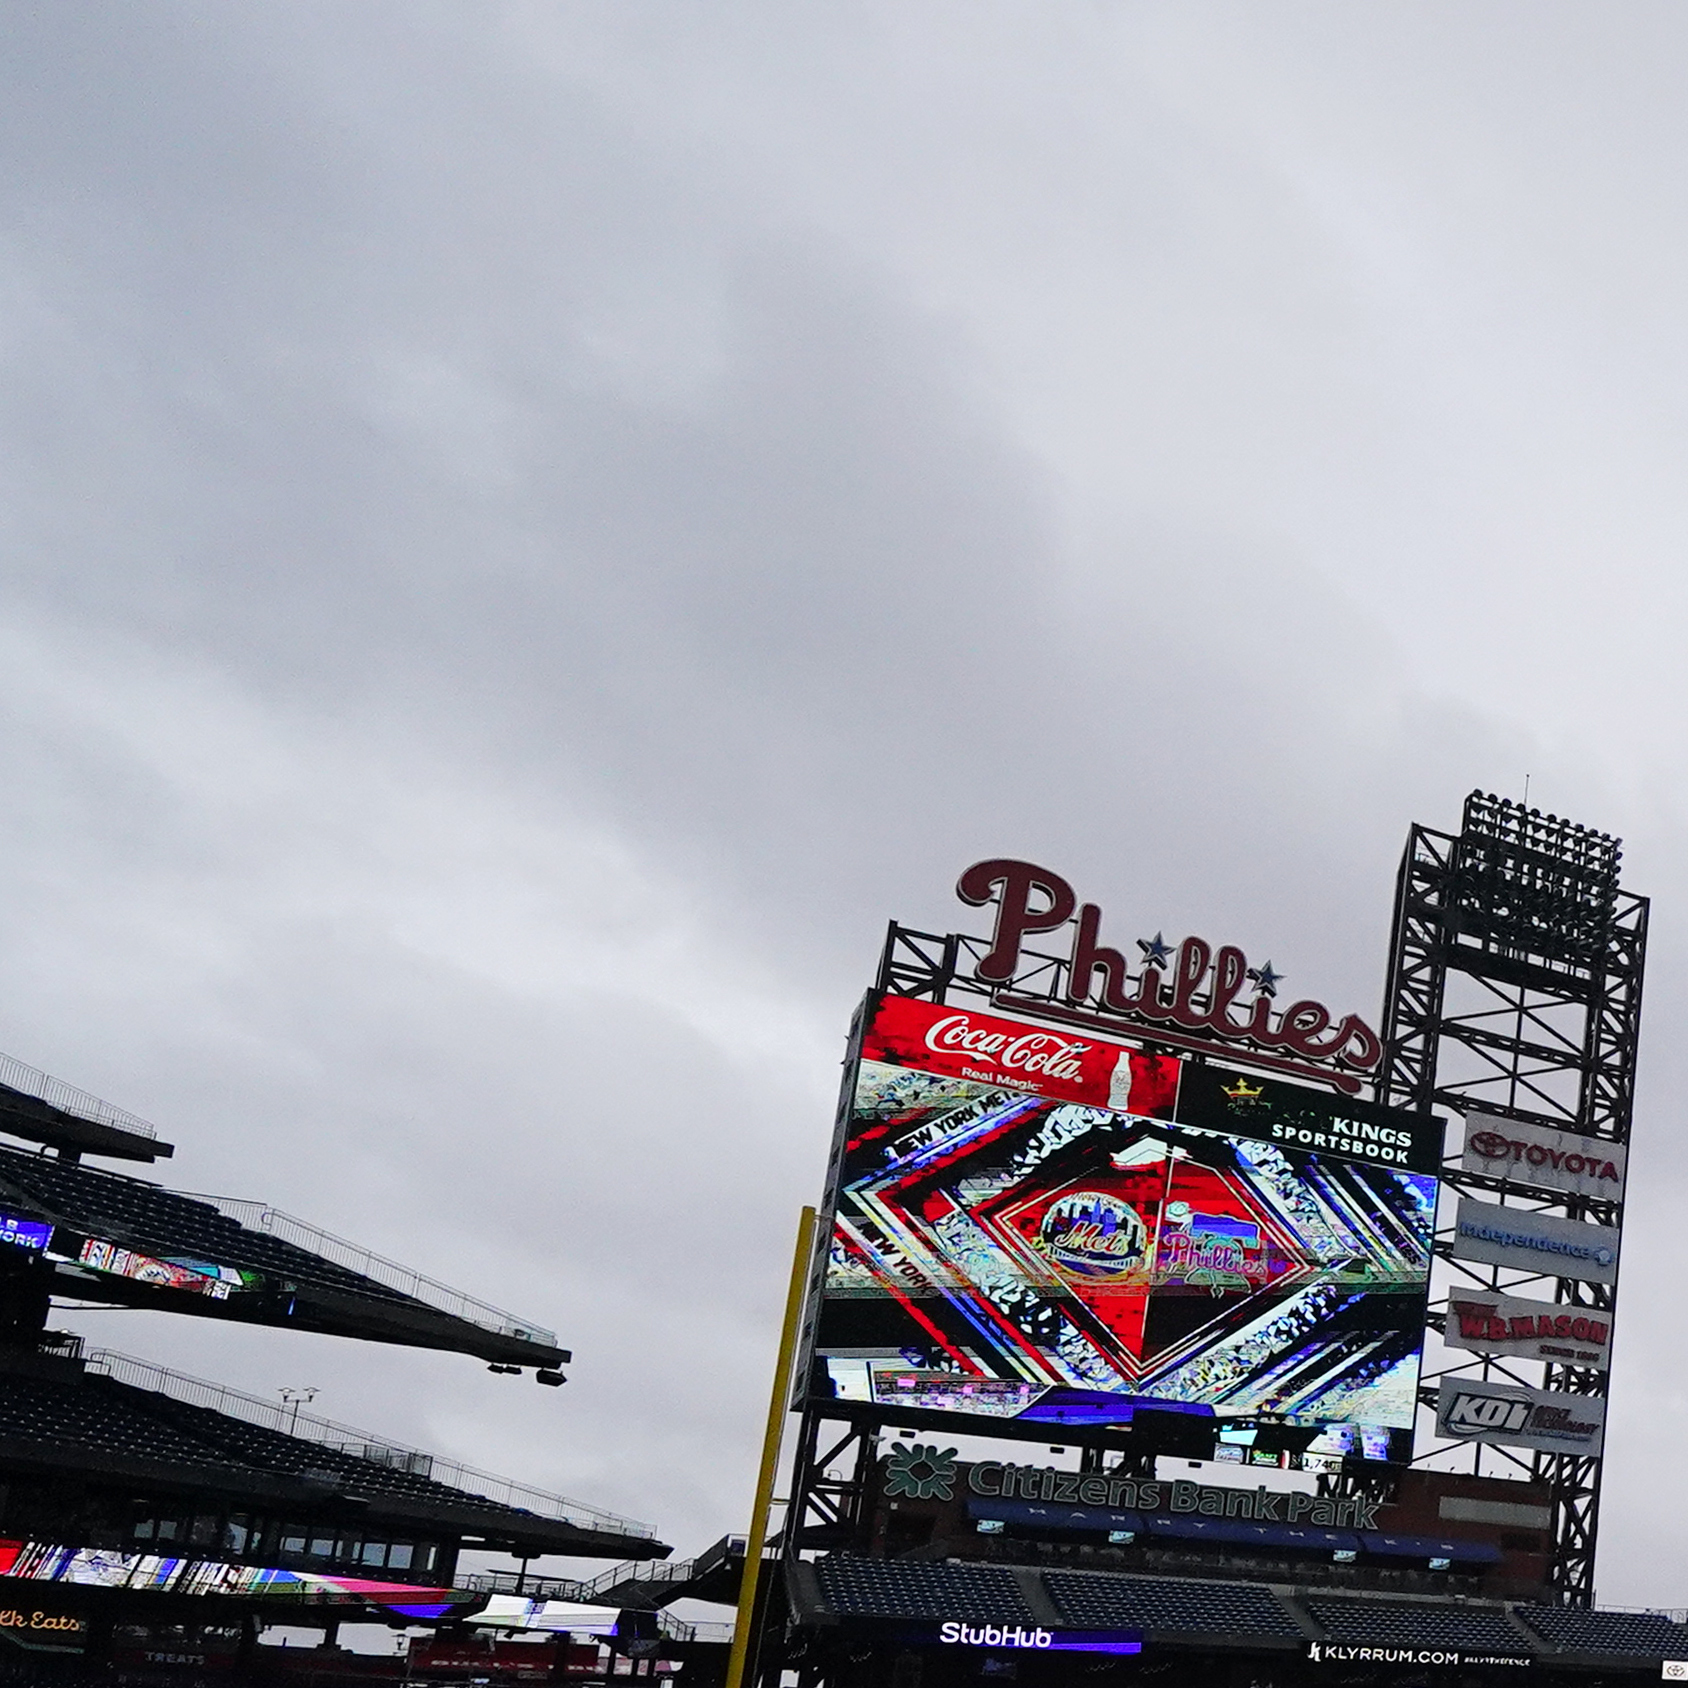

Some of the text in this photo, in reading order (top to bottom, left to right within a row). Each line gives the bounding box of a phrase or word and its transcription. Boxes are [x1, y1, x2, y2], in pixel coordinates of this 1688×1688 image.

[957, 859, 1384, 1070] Phillies
[925, 1015, 1092, 1082] Coca-Cola
[961, 1066, 1042, 1093] Real Magic
[933, 1105, 980, 1135] YORK
[1271, 1123, 1409, 1164] SPORTSBOOK
[1509, 1139, 1619, 1183] TOYOTA
[1054, 1220, 1128, 1255] Mets
[1459, 1220, 1591, 1259] Independence
[967, 1460, 1380, 1531] Citizens Bank Park
[29, 1610, 81, 1632] Eats
[940, 1621, 1052, 1649] StubHub
[1324, 1645, 1460, 1666] KLYRRUM.COM
